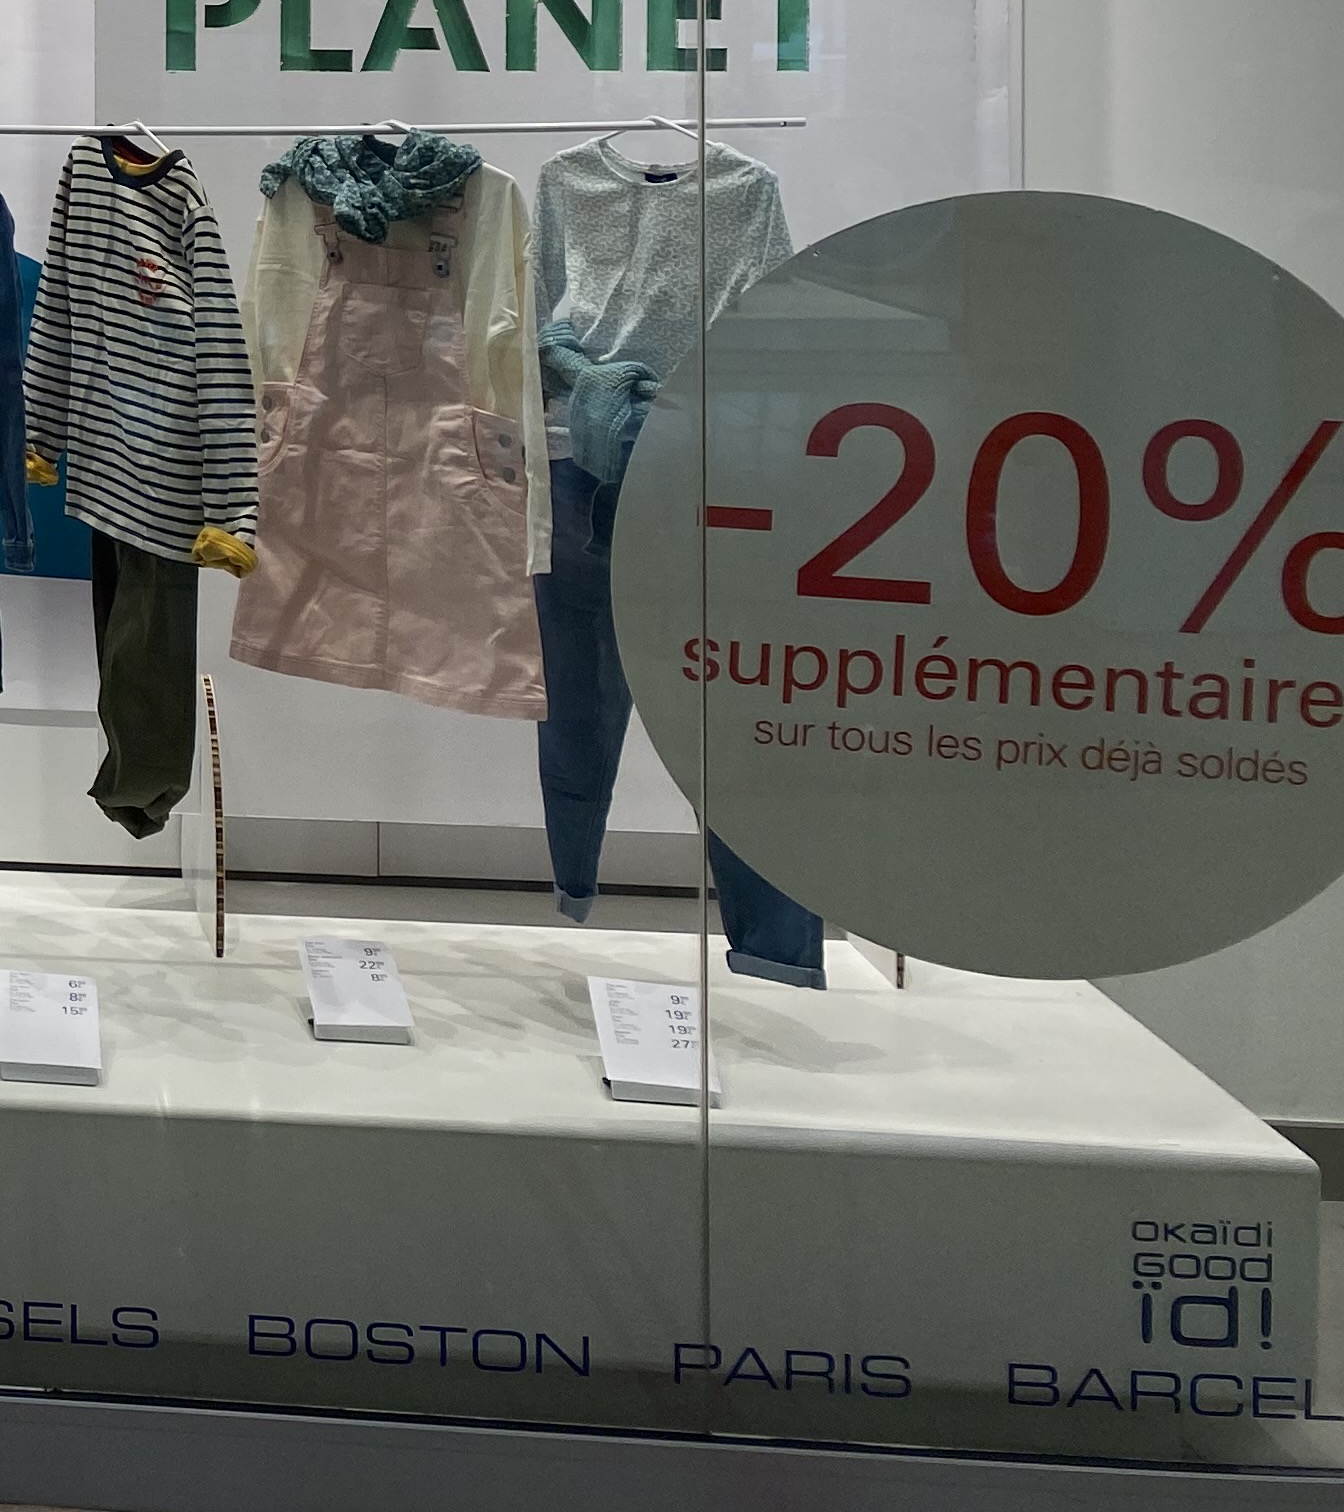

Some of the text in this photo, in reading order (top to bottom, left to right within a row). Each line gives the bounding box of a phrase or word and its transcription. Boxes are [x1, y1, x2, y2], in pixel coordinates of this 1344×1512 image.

[753, 718, 1310, 786] sur tous les prix déjà soldés
[247, 1313, 592, 1378] BOSTON
[673, 1341, 912, 1398] PARIS
